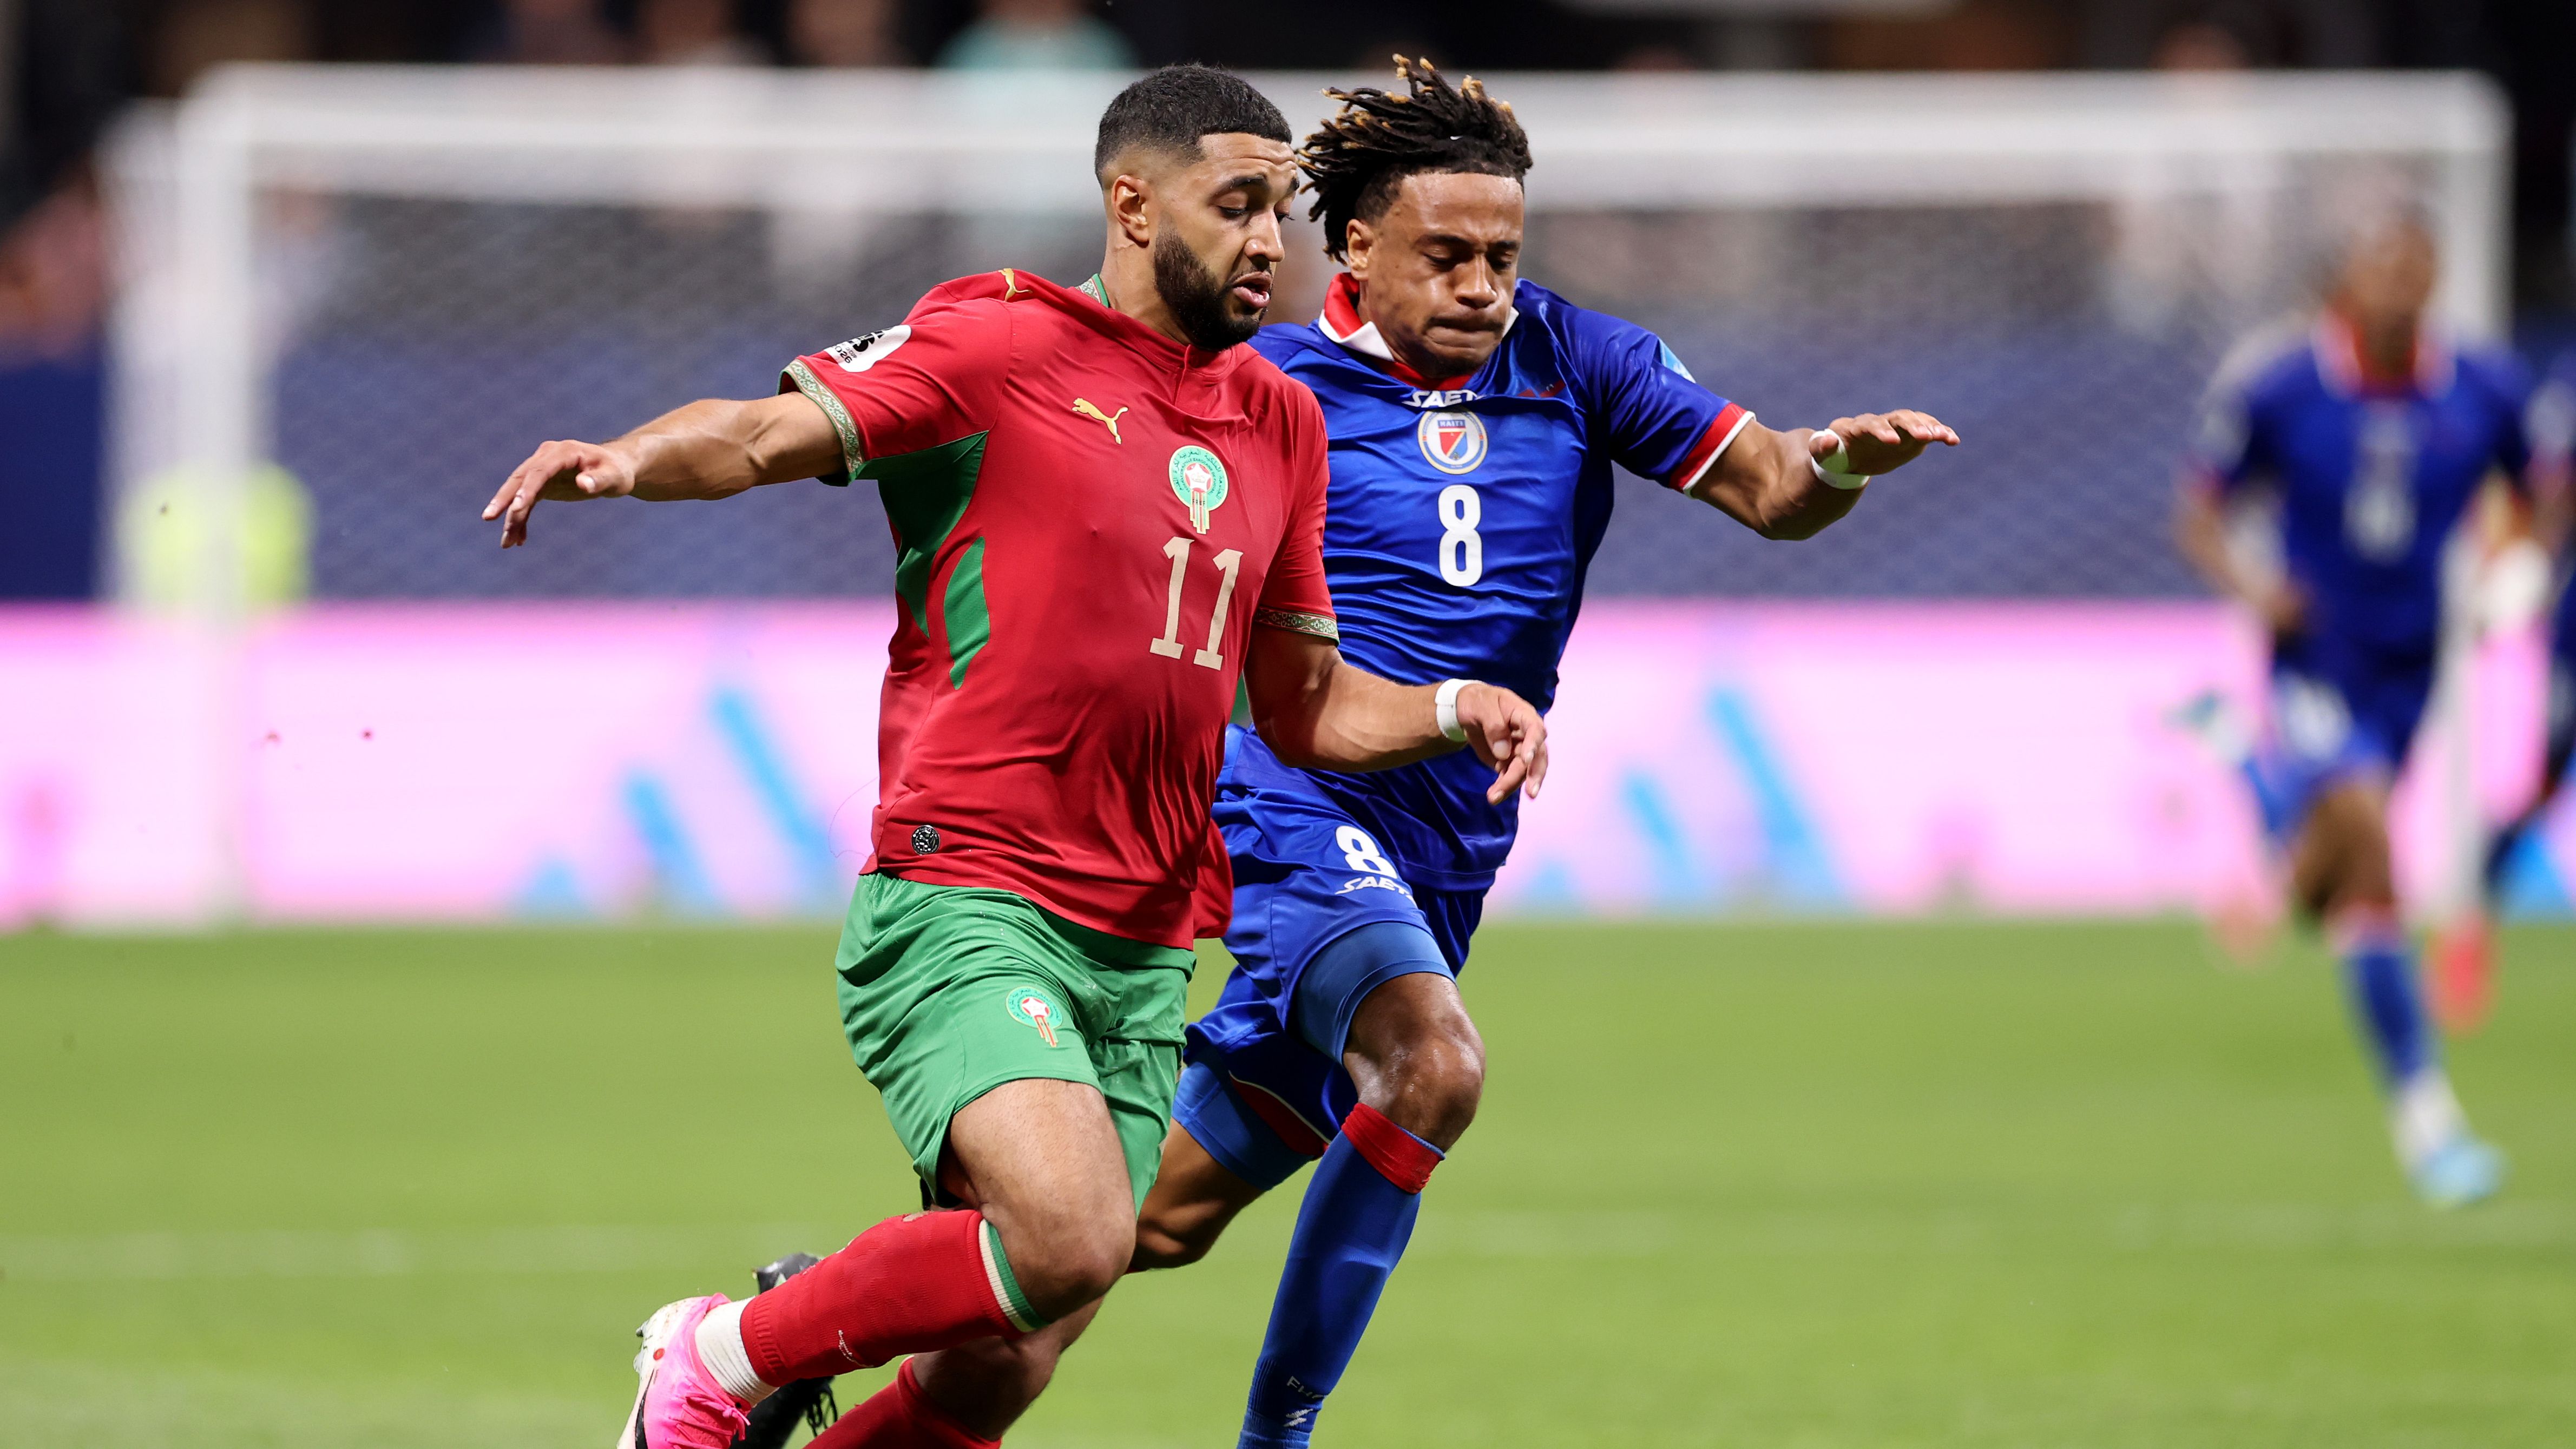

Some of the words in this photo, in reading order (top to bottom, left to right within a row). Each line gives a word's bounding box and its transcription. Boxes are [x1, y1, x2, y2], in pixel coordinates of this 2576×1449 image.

[833, 346, 852, 364] 026
[1402, 390, 1487, 408] SAET
[1438, 484, 1482, 587] 8
[1149, 536, 1244, 671] 11
[1336, 825, 1398, 879] 8
